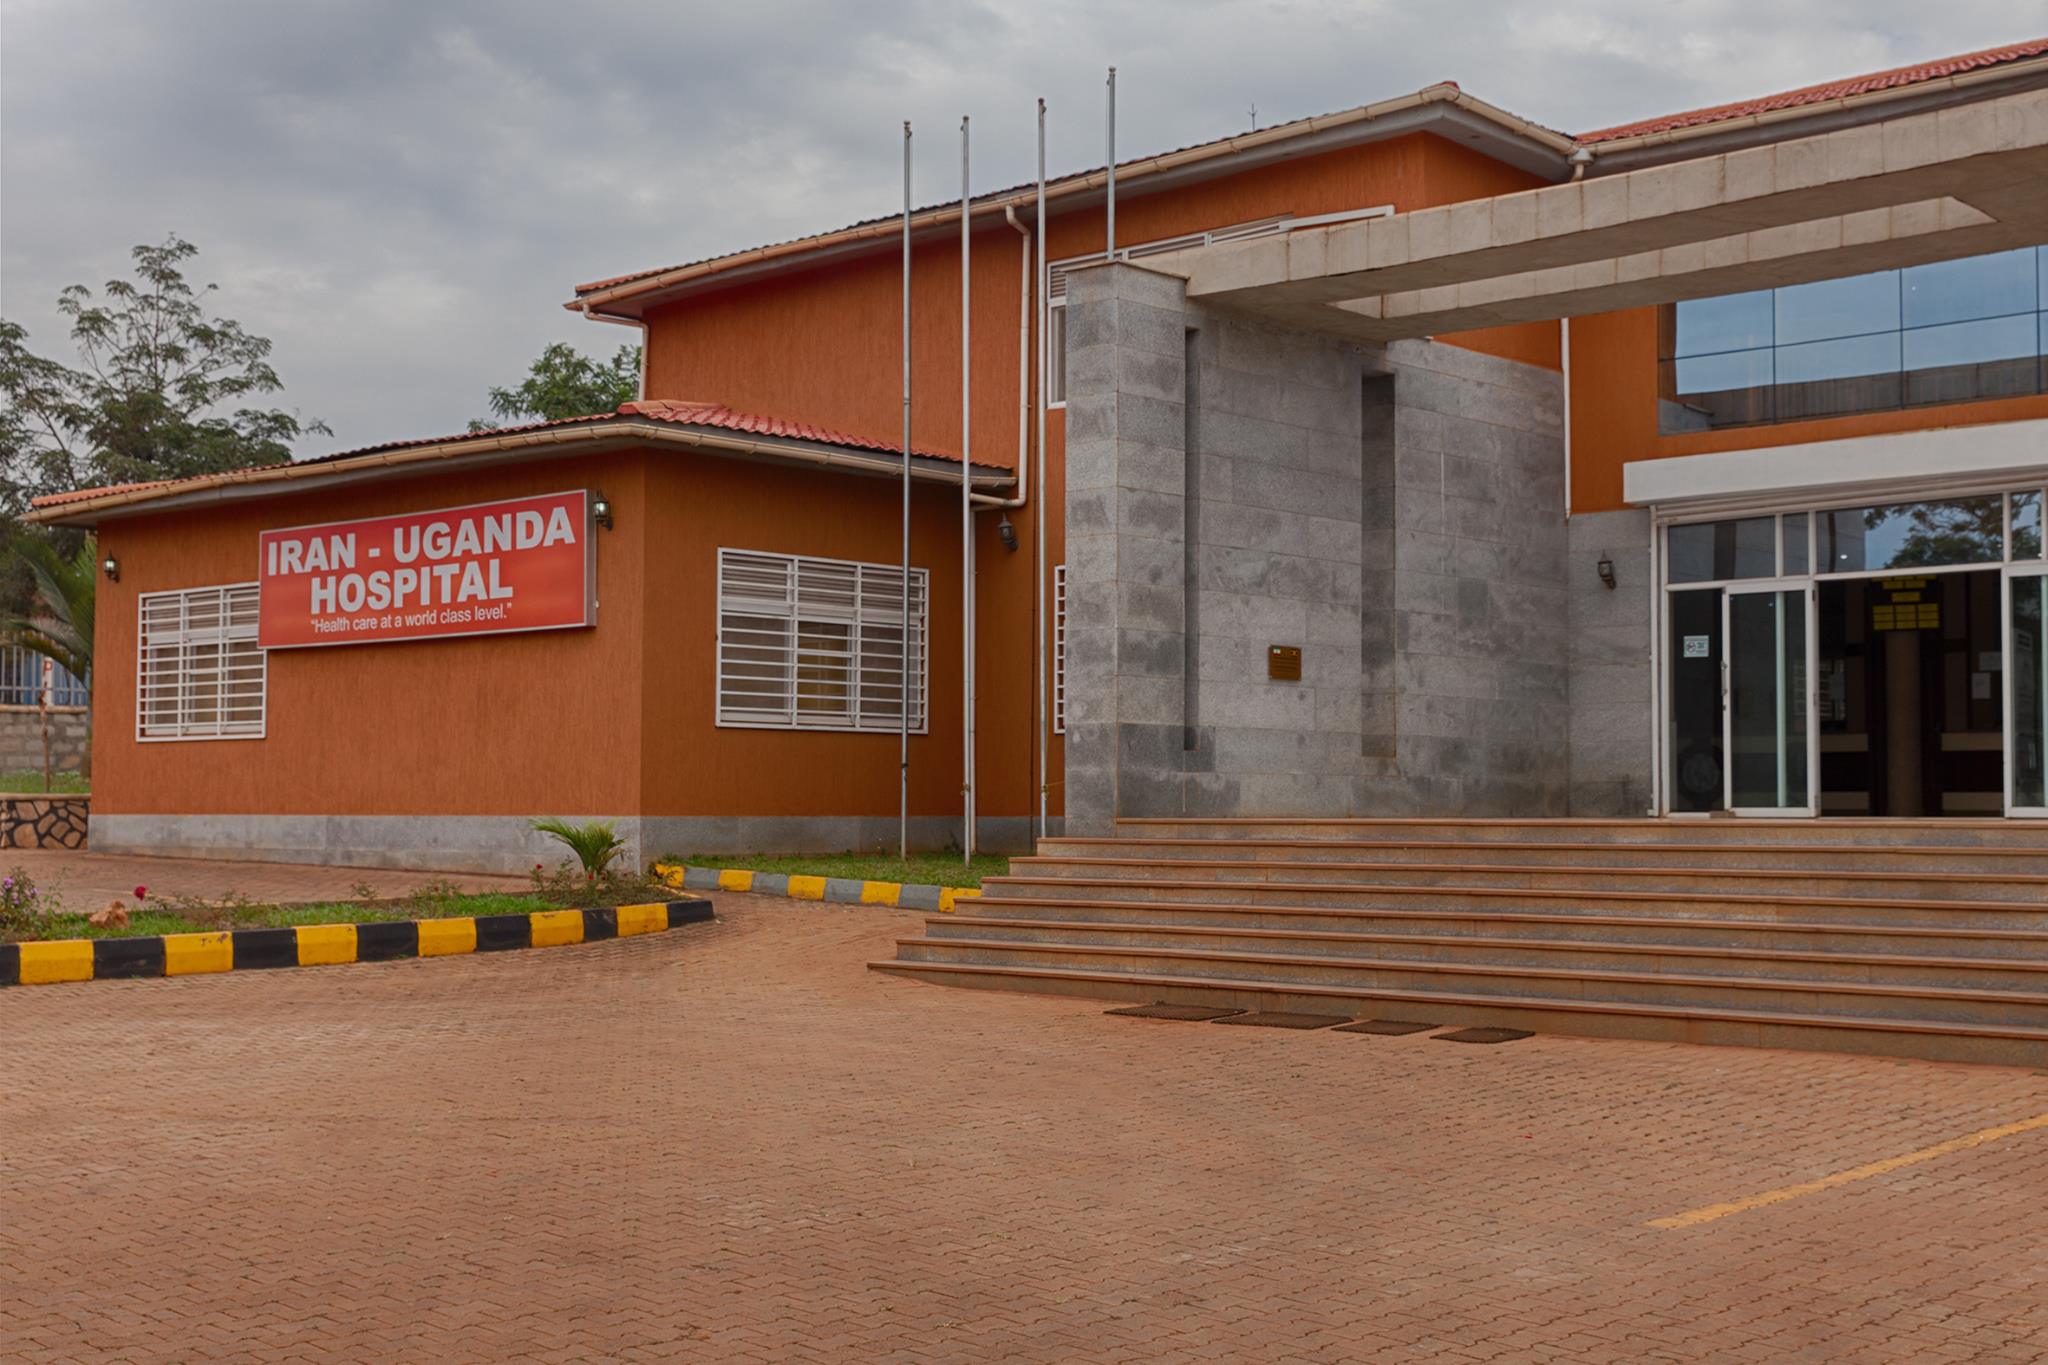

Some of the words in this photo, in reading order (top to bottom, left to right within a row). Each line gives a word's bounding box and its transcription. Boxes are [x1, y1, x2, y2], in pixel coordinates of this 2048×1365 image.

[267, 533, 356, 576] IRAN
[368, 547, 380, 558] -
[393, 506, 575, 564] UGANDA
[310, 558, 513, 615] HOSPITAL
[352, 617, 377, 630] care
[380, 615, 392, 629] at
[394, 616, 403, 628] a
[404, 611, 437, 627] world
[440, 608, 471, 624] class
